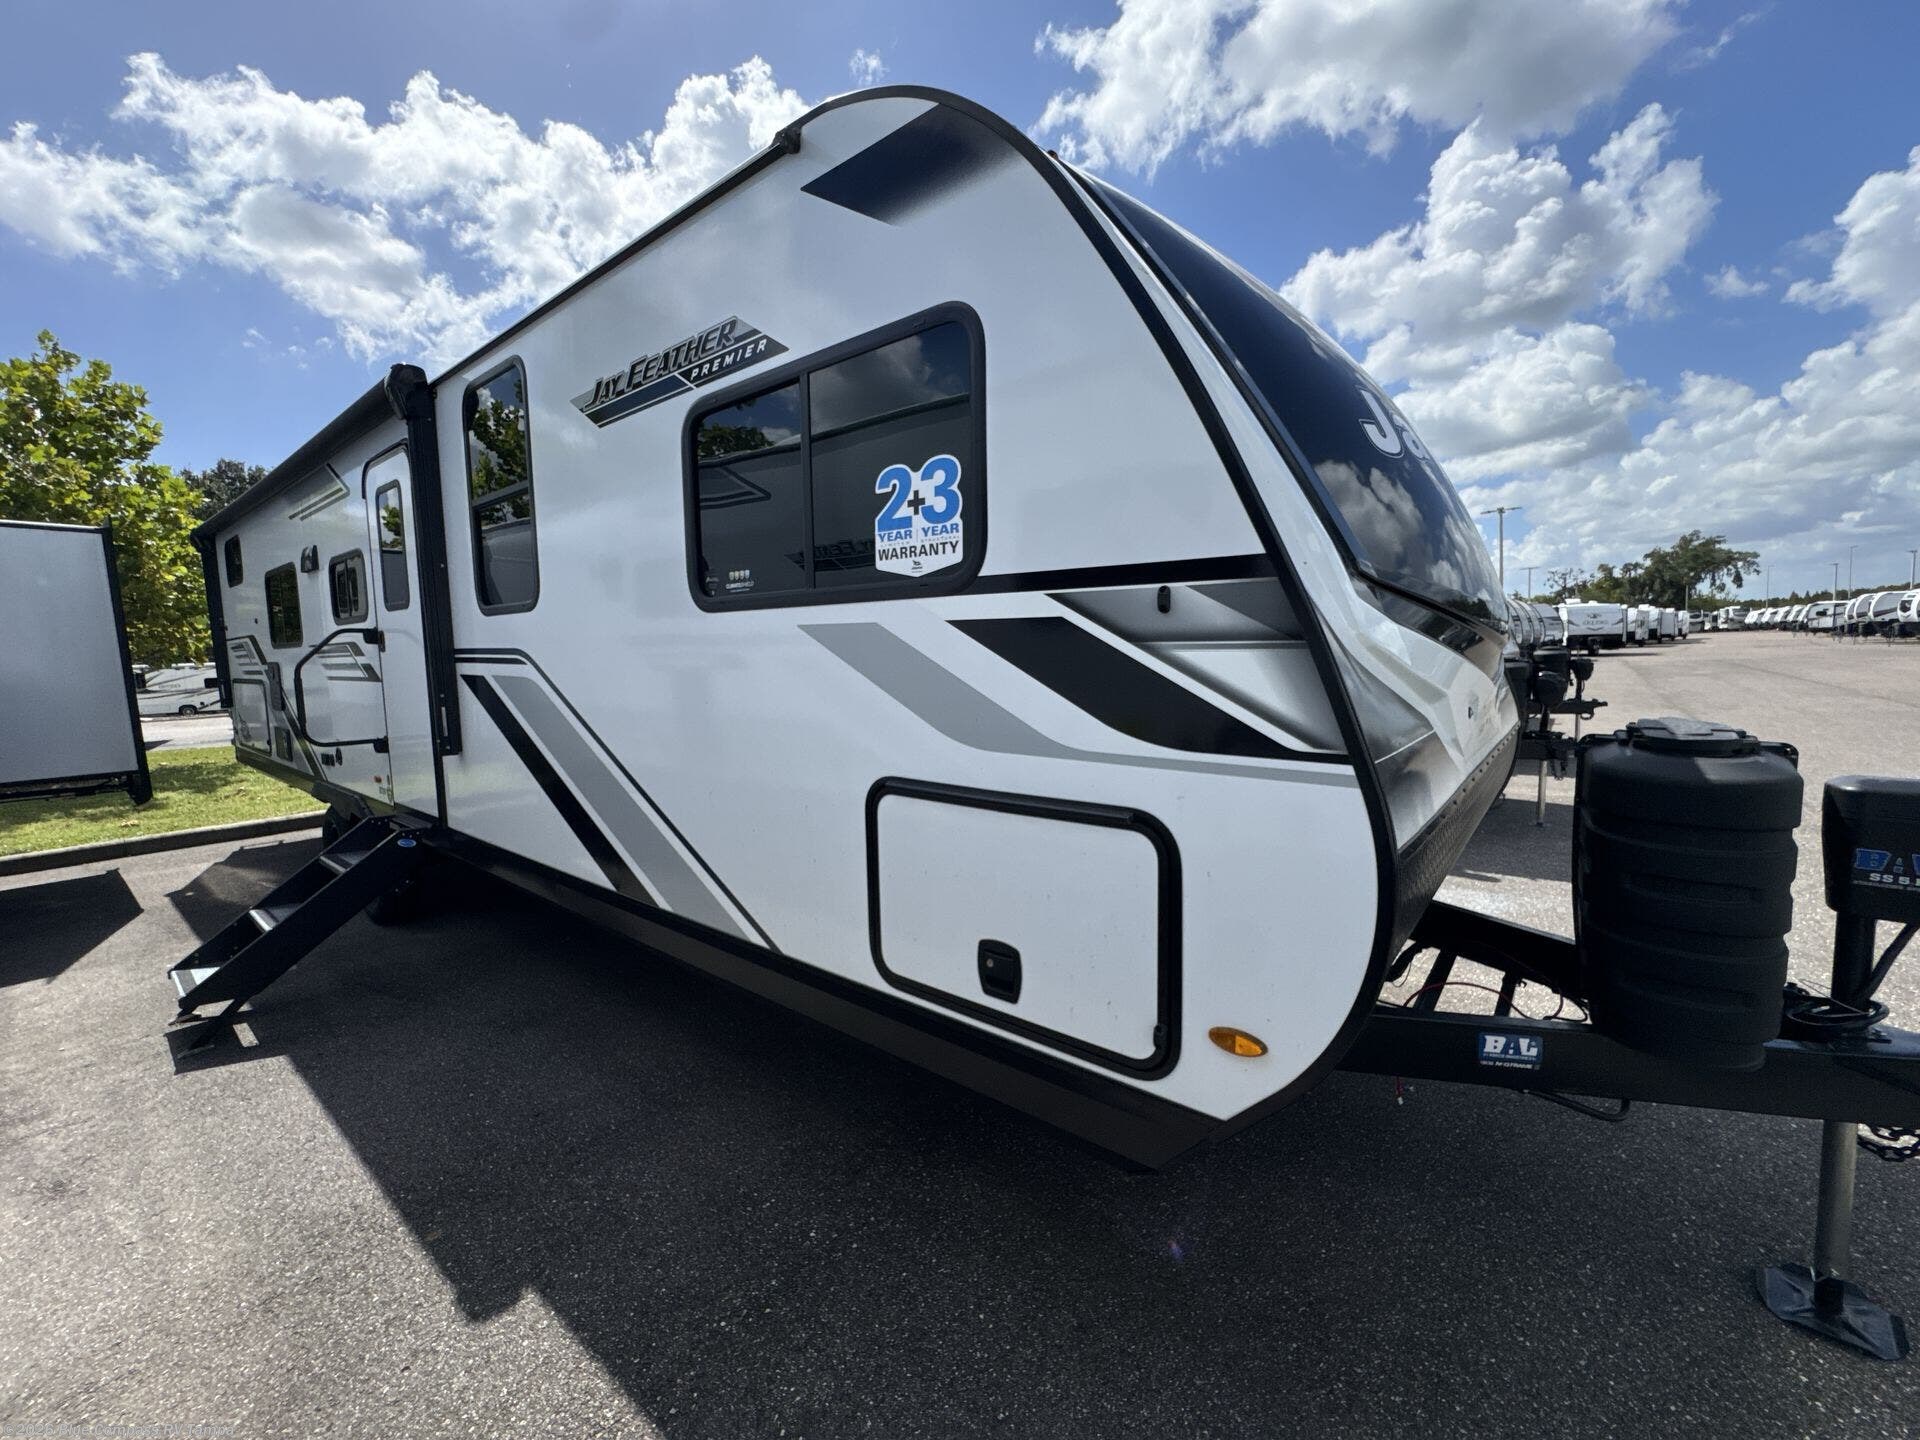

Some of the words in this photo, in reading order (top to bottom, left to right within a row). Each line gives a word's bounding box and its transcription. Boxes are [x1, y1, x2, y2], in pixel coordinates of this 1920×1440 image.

[583, 371, 625, 410] JAY
[626, 316, 737, 392] FEATHER
[690, 338, 768, 380] PREMIER
[878, 529, 913, 542] YEAR
[921, 523, 960, 537] YEAR
[878, 540, 959, 561] WARRANTY
[1855, 848, 1920, 876] BA
[1483, 1035, 1538, 1056] BAL
